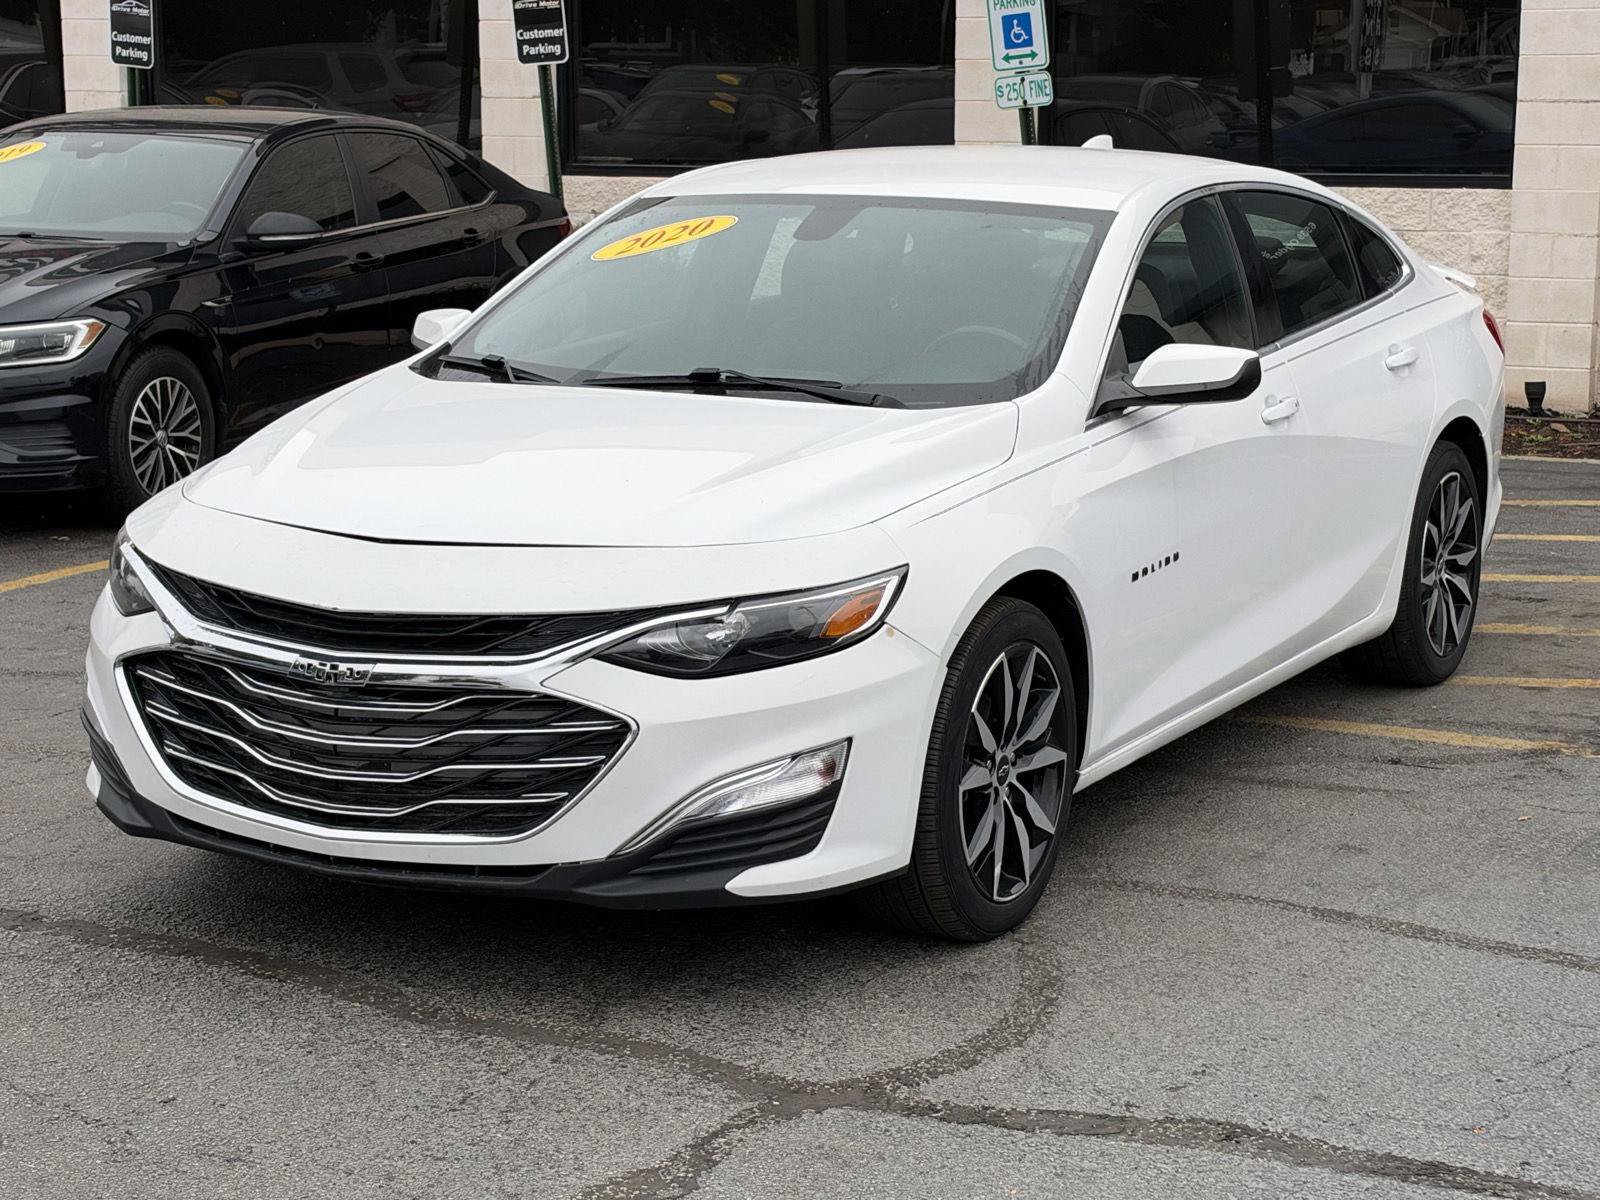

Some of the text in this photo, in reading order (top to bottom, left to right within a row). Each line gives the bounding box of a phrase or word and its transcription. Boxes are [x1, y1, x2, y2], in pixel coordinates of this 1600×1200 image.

[112, 30, 151, 44] Customer
[517, 28, 563, 40] Customer
[116, 46, 148, 61] Parking
[522, 43, 561, 56] Parking
[1029, 79, 1050, 97] FINE
[615, 218, 715, 255] 2020
[1131, 551, 1179, 583] MALIBU
